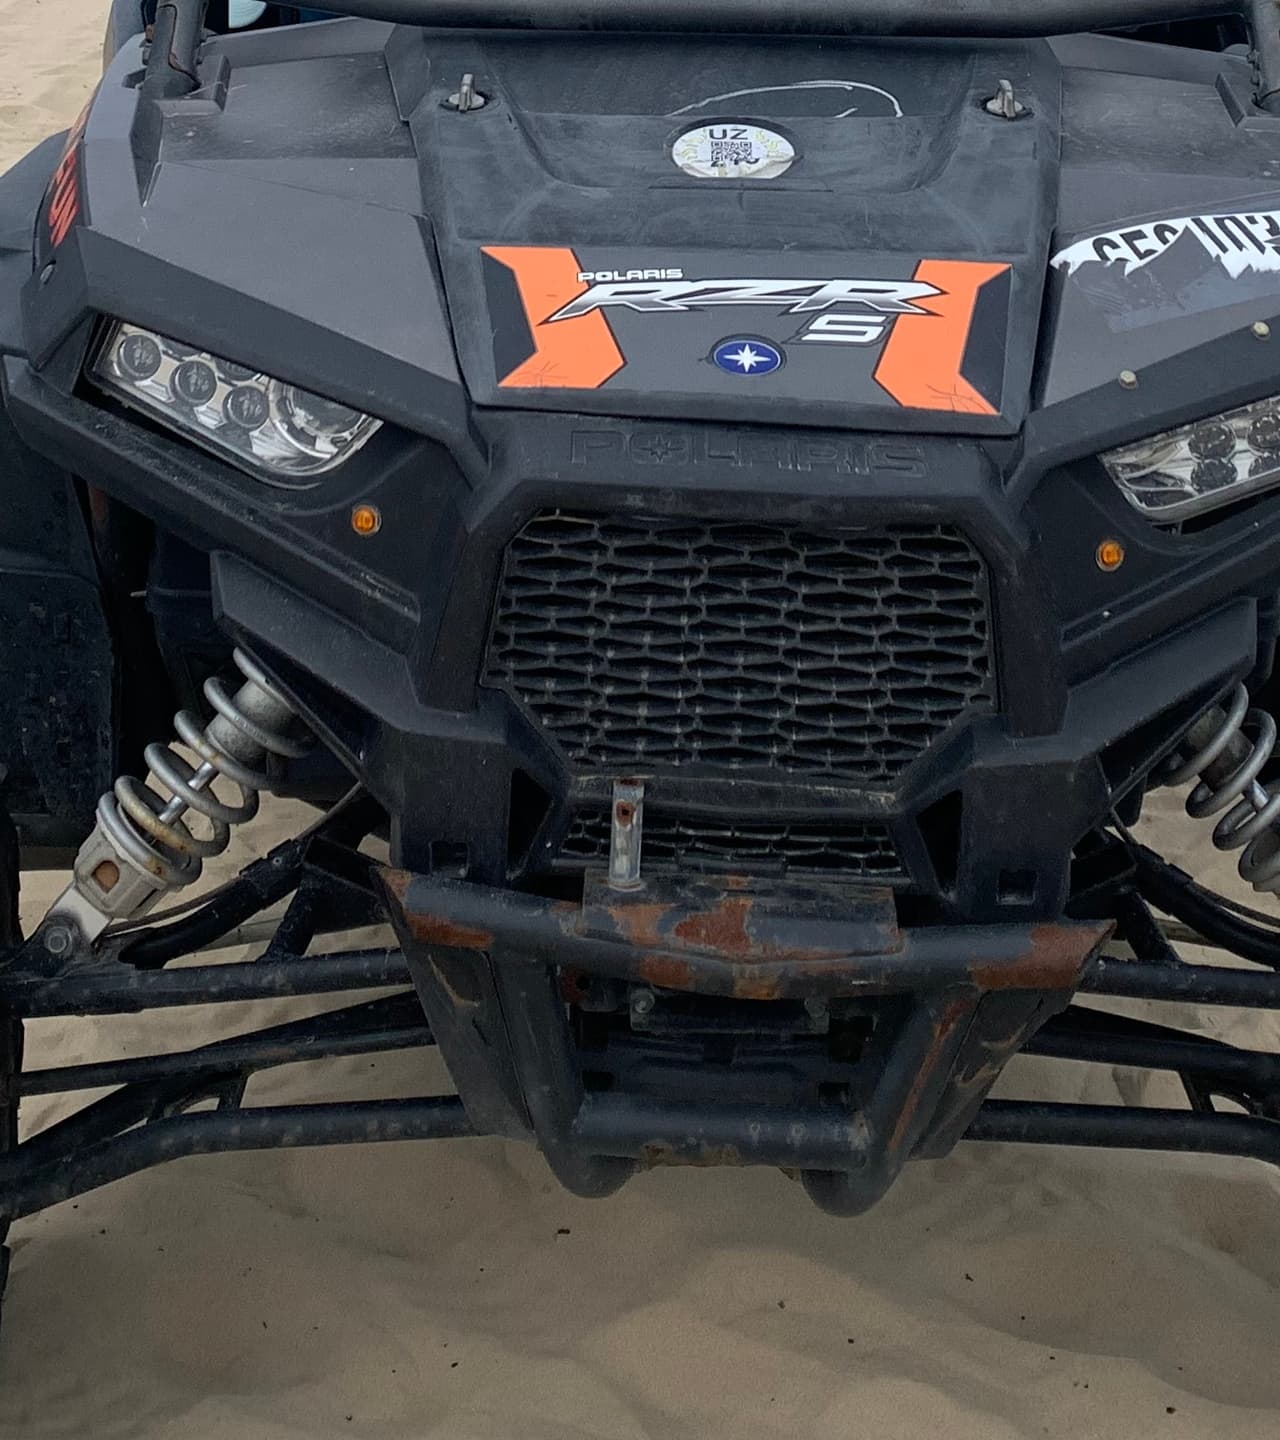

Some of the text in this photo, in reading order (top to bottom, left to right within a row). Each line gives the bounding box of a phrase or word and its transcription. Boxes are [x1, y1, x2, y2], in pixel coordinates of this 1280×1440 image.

[708, 128, 749, 141] UZ
[576, 267, 684, 282] POLARIS
[537, 278, 949, 326] RZR
[796, 312, 891, 345] S
[569, 429, 927, 477] POLARIS
